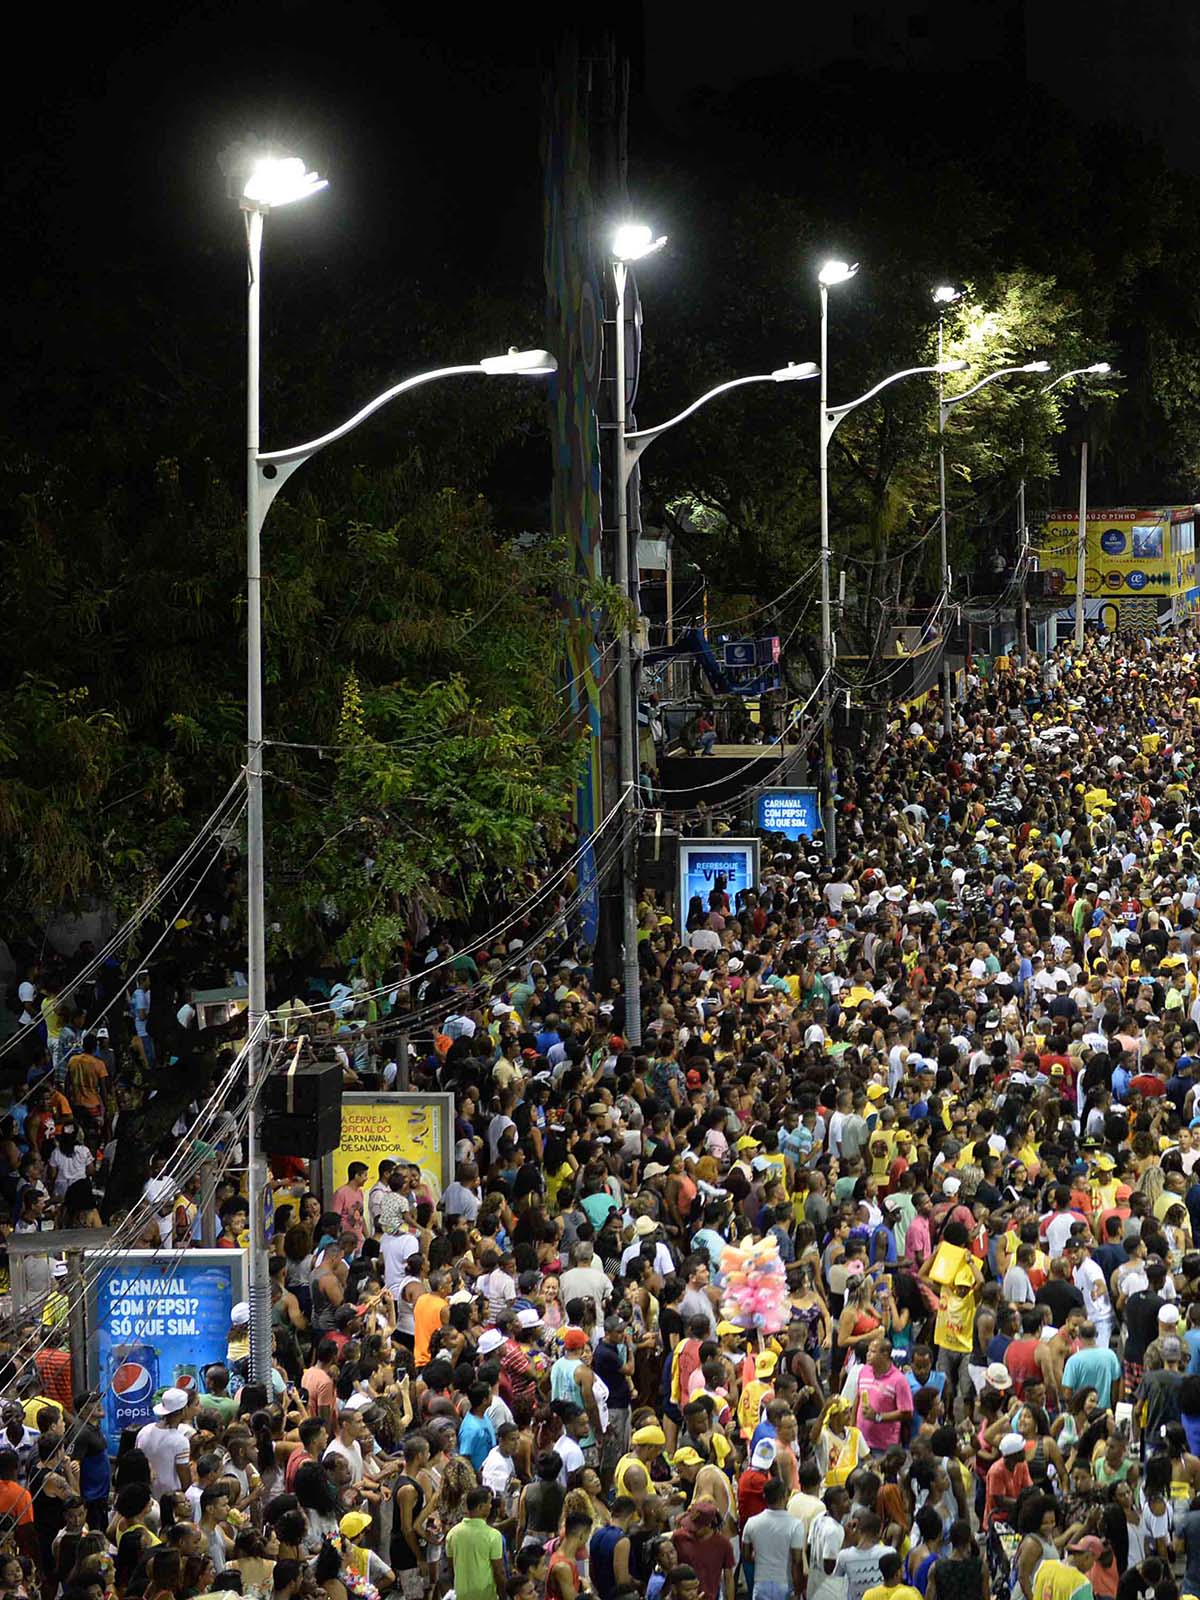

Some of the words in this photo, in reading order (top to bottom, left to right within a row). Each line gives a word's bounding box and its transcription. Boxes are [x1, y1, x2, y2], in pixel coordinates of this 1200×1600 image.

[1074, 512, 1107, 520] AAÚJO
[764, 809, 781, 817] COM
[782, 809, 807, 817] PEPSI?
[776, 818, 790, 828] QUE
[696, 862, 738, 870] REFRESQUE
[349, 1116, 388, 1124] CERVEJA
[342, 1125, 374, 1133] OFICIAL
[377, 1125, 391, 1133] DO
[342, 1134, 389, 1142] CARNAVAL
[342, 1144, 353, 1152] DE
[110, 1279, 188, 1296] CARNAVAL
[110, 1299, 143, 1315] COM
[147, 1298, 199, 1315] PEPSI?
[111, 1316, 132, 1336] SÓ
[135, 1319, 164, 1337] QUE
[167, 1319, 200, 1336] SIM.
[116, 1407, 150, 1418] pepsi
